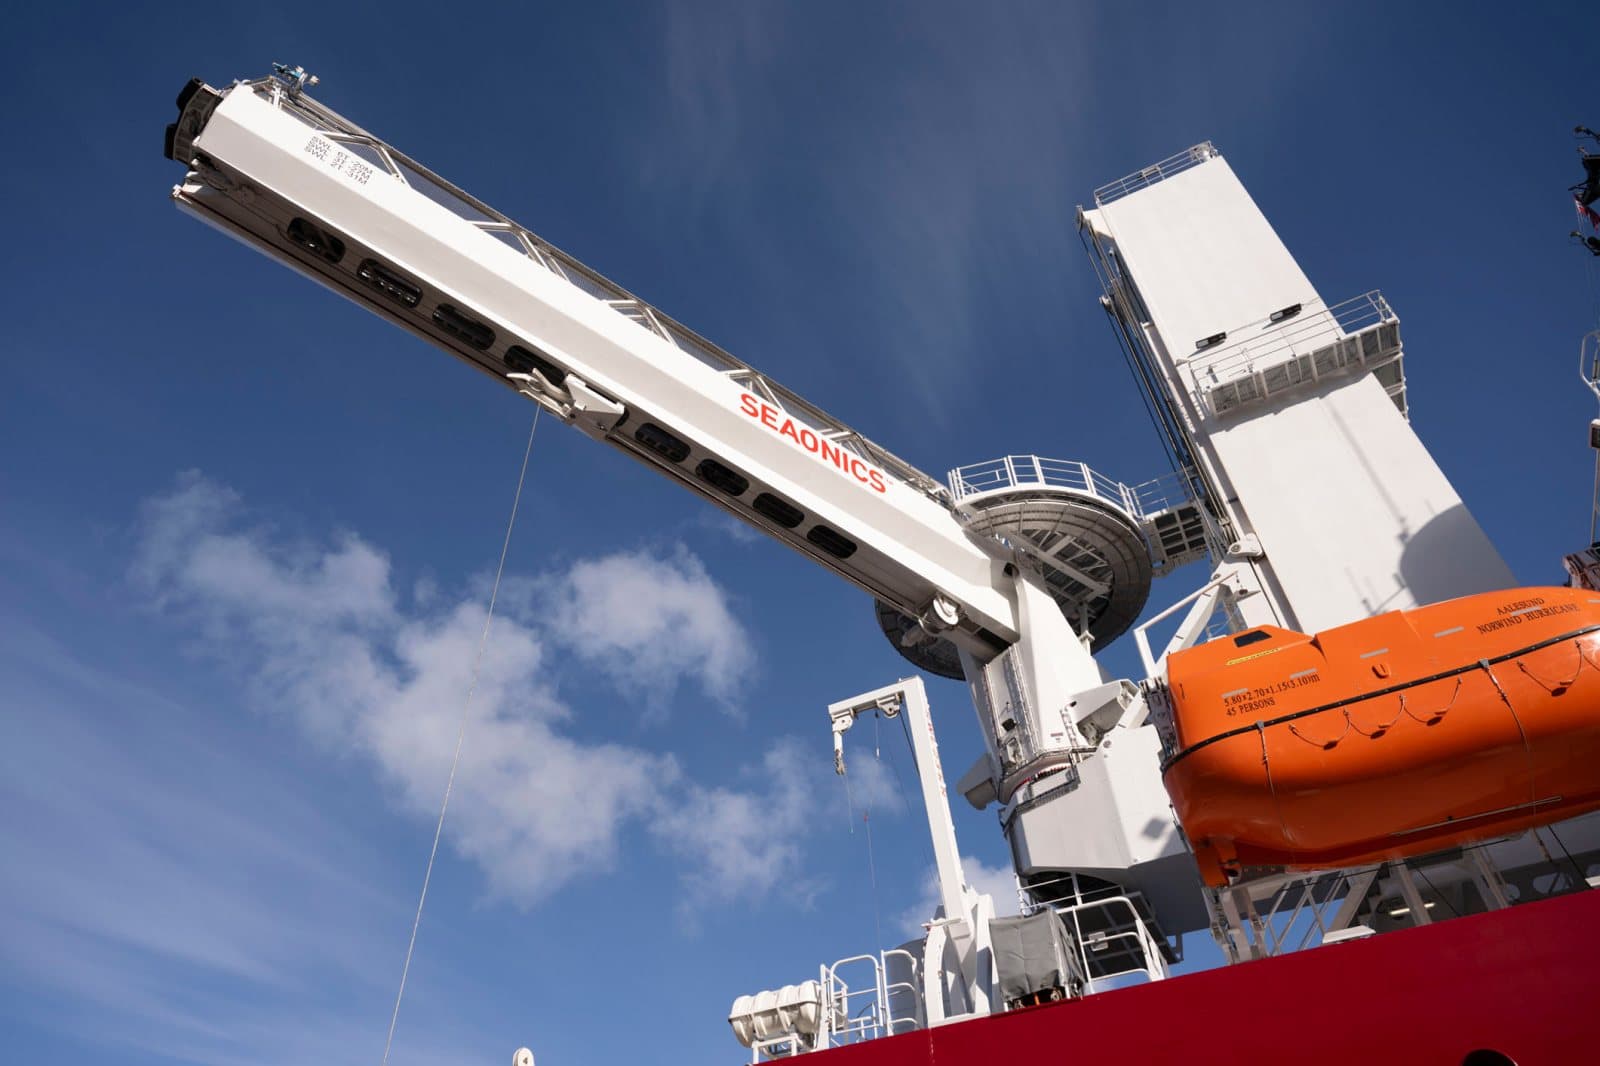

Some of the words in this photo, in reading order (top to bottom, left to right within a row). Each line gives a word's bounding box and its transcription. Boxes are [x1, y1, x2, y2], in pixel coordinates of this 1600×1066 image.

[308, 140, 328, 155] SWL
[311, 136, 331, 150] SWL
[304, 145, 326, 160] SWL
[740, 393, 886, 493] SEAONICS
[1496, 598, 1545, 616] AALESUND
[1476, 615, 1522, 634] NORWIND
[1523, 603, 1579, 621] HURRICANE
[1226, 706, 1237, 717] 45
[1239, 696, 1276, 715] PERSONS
